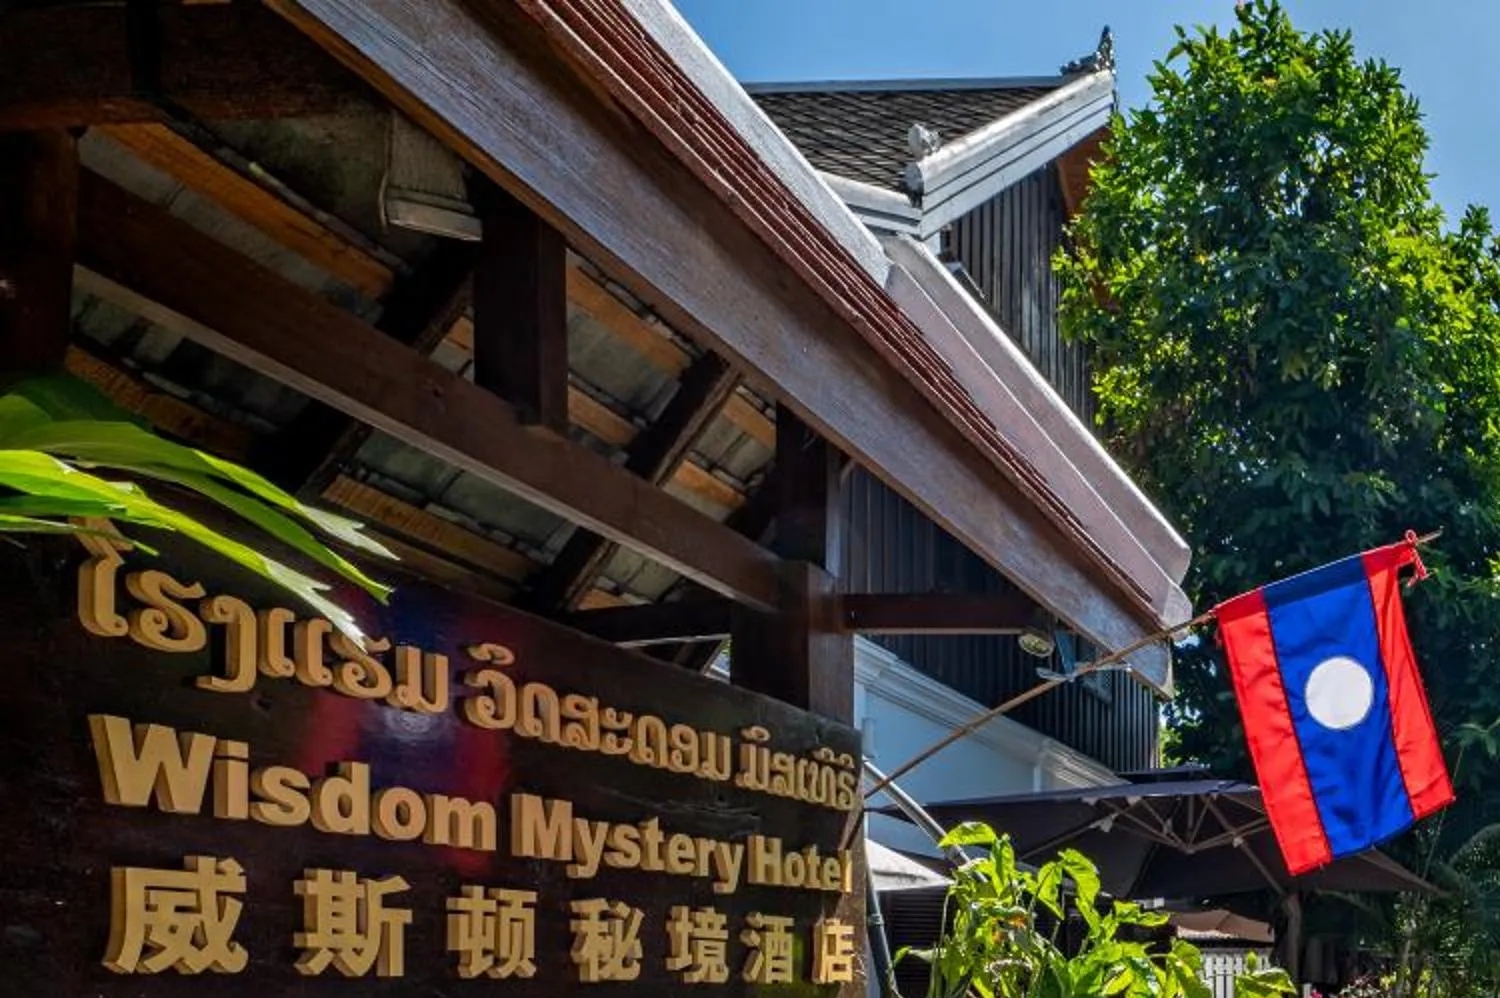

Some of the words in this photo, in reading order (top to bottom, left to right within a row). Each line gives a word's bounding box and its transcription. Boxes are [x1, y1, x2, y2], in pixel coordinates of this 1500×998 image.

[88, 713, 498, 851] Wisdom
[511, 792, 744, 894] Mystery
[747, 834, 853, 893] Hotel
[102, 856, 854, 984] 威斯顿秘境酒店
